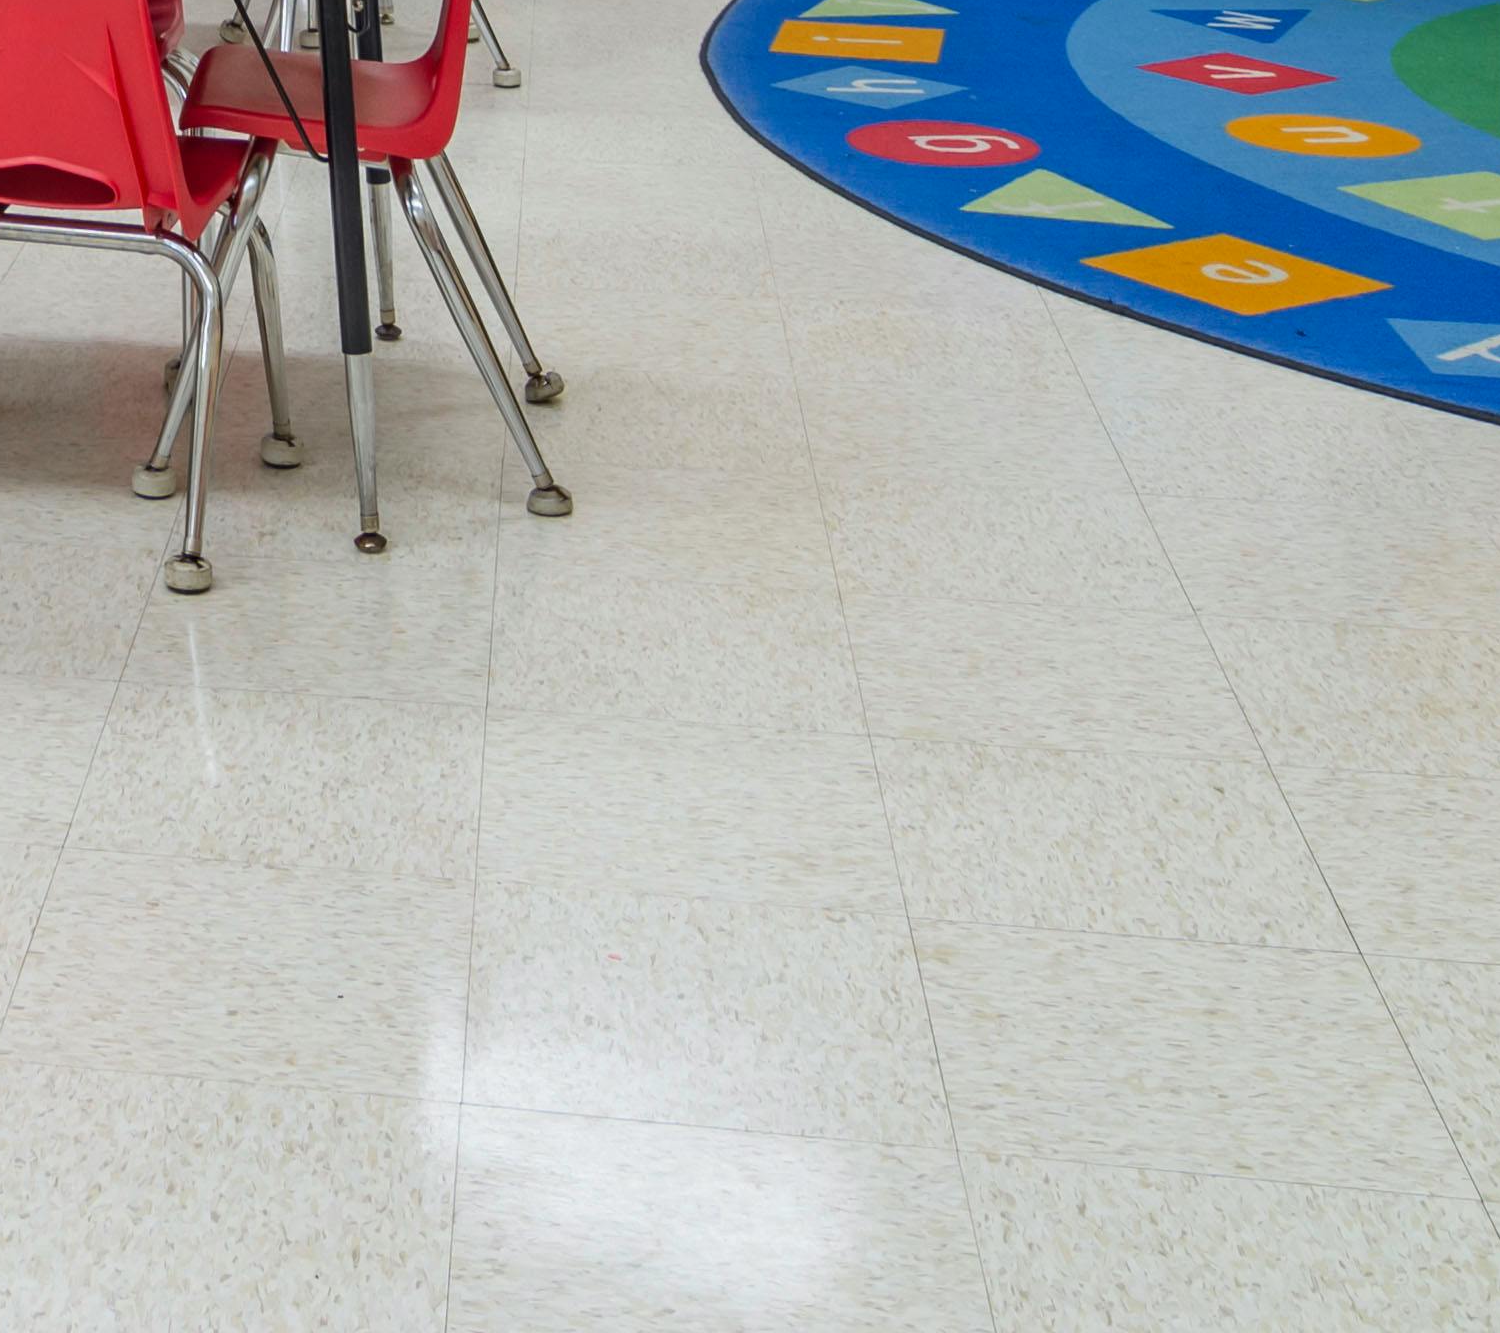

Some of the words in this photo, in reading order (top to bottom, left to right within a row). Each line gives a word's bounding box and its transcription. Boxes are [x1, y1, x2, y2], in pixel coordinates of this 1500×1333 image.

[826, 79, 925, 94] h
[908, 135, 1020, 153] g
[1201, 260, 1289, 284] e
